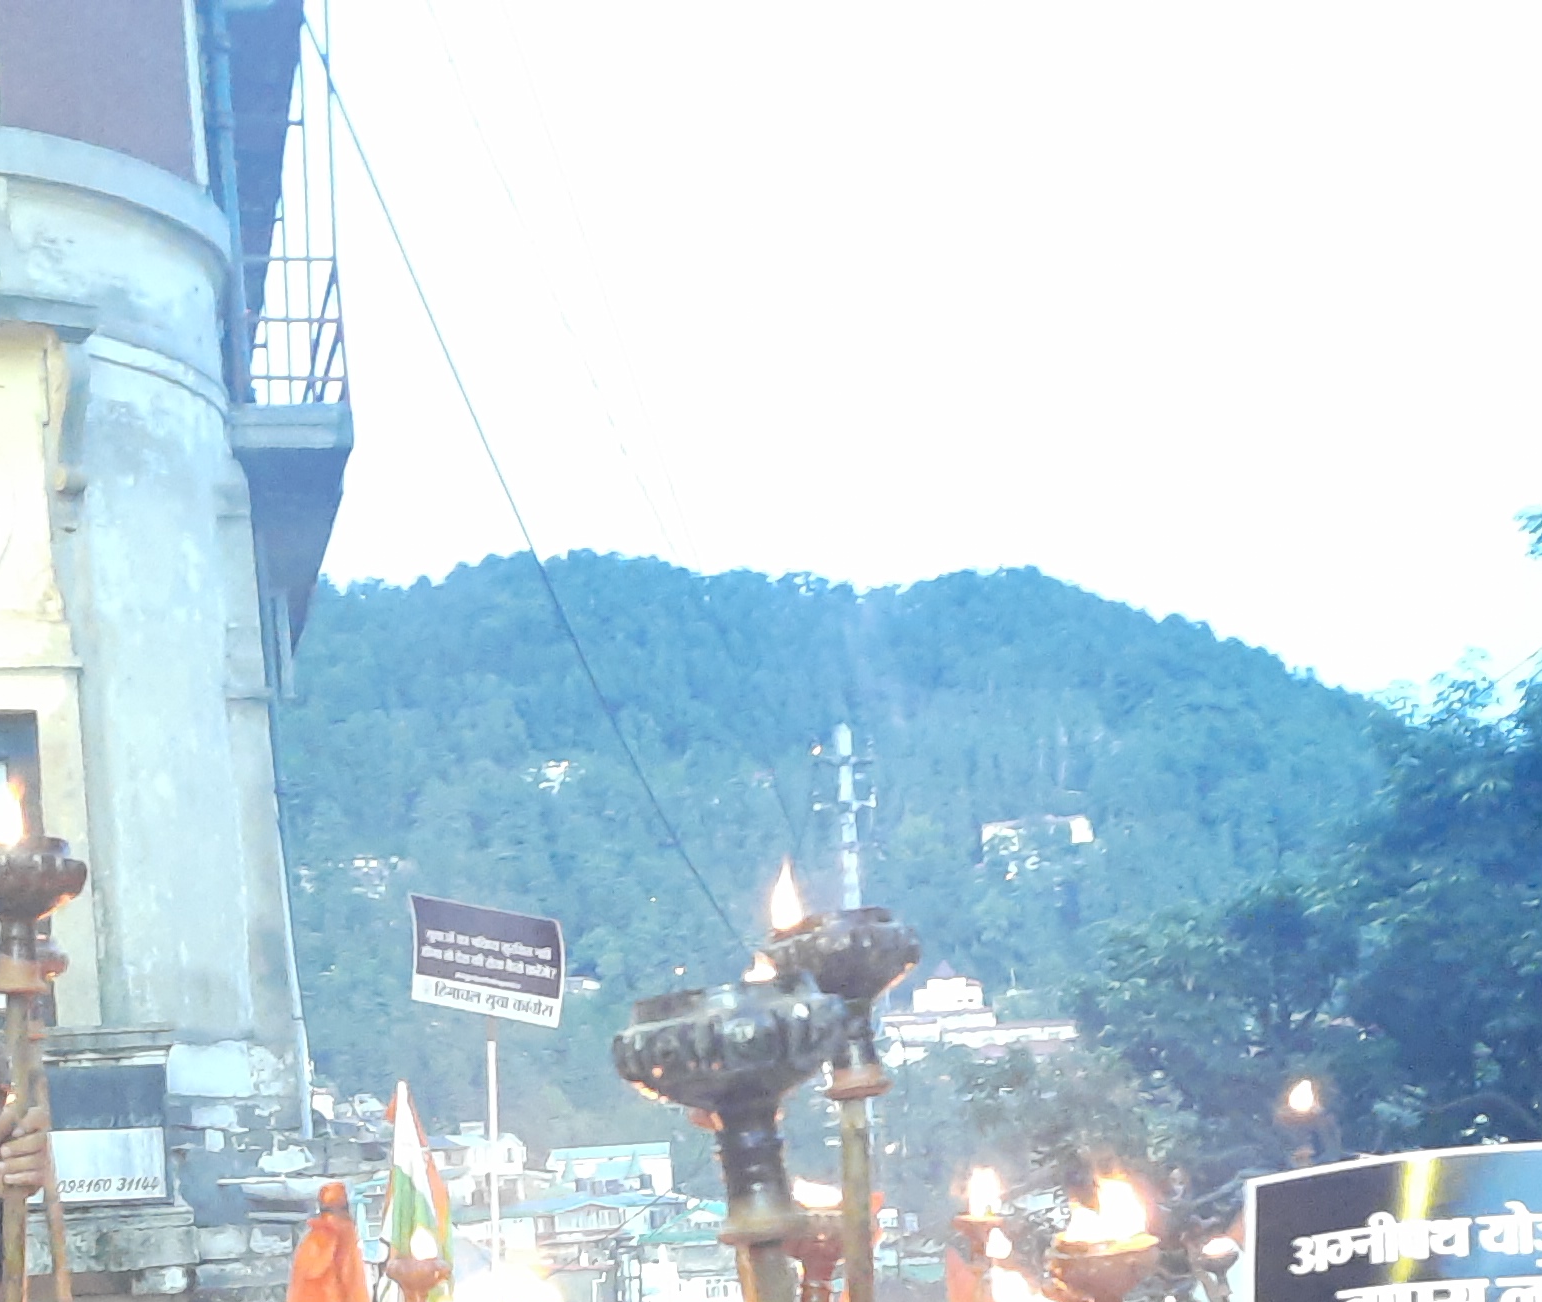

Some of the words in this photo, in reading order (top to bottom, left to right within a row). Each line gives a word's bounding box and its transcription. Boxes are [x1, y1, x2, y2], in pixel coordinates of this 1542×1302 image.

[434, 980, 481, 1004] हिमाचल
[485, 993, 509, 1011] युवा
[116, 1176, 159, 1192] 31144
